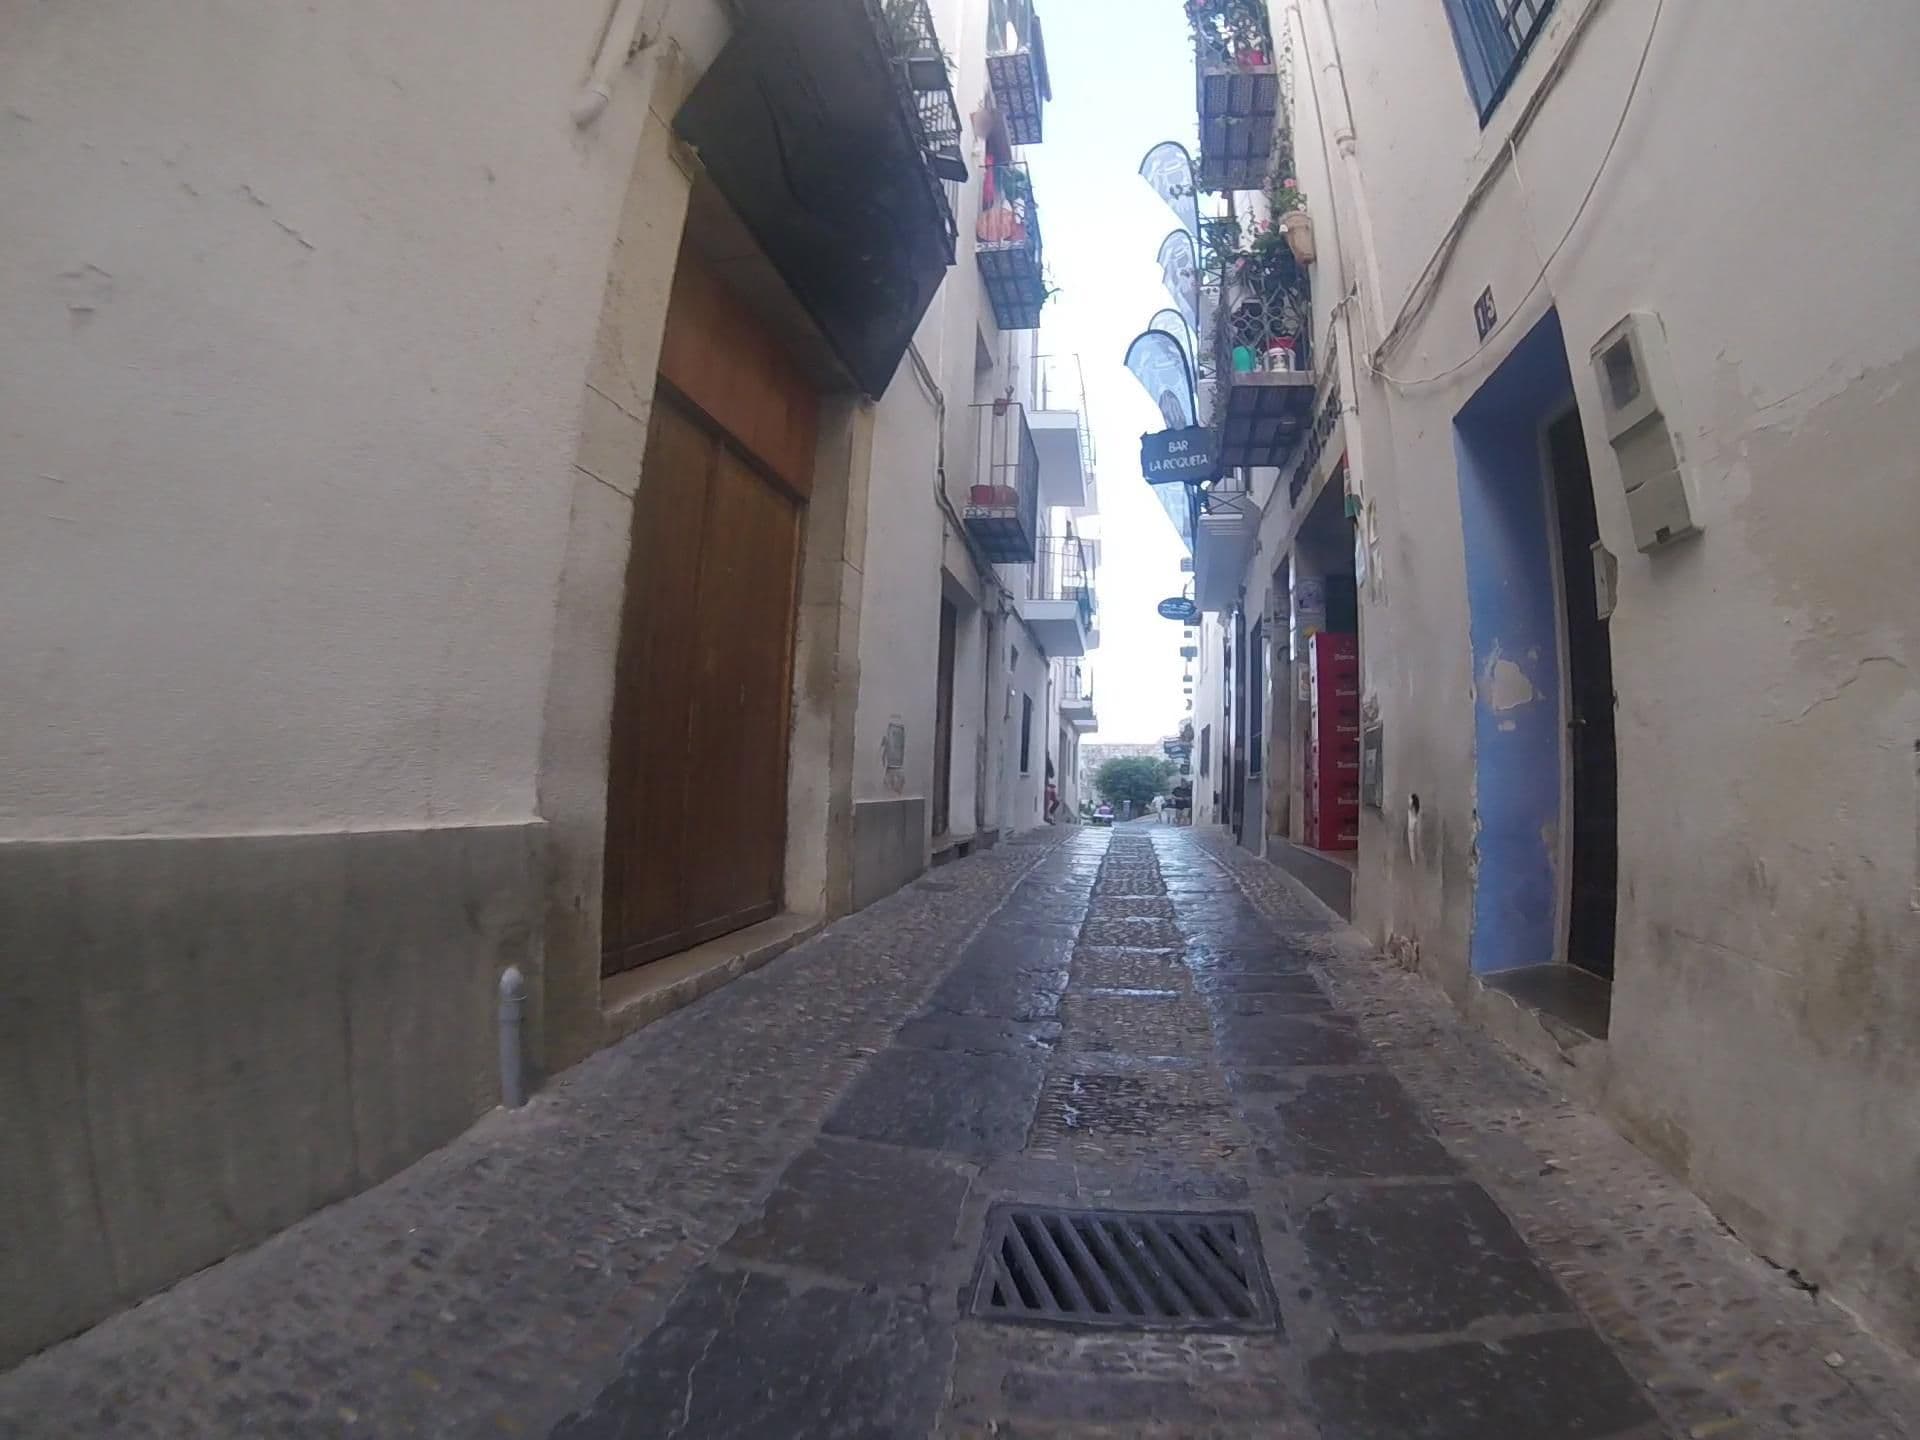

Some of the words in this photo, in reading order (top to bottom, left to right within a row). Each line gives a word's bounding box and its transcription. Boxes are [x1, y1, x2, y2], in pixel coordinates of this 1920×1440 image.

[1477, 292, 1495, 331] 15
[1168, 440, 1189, 453] BAR
[1149, 460, 1162, 472] LA
